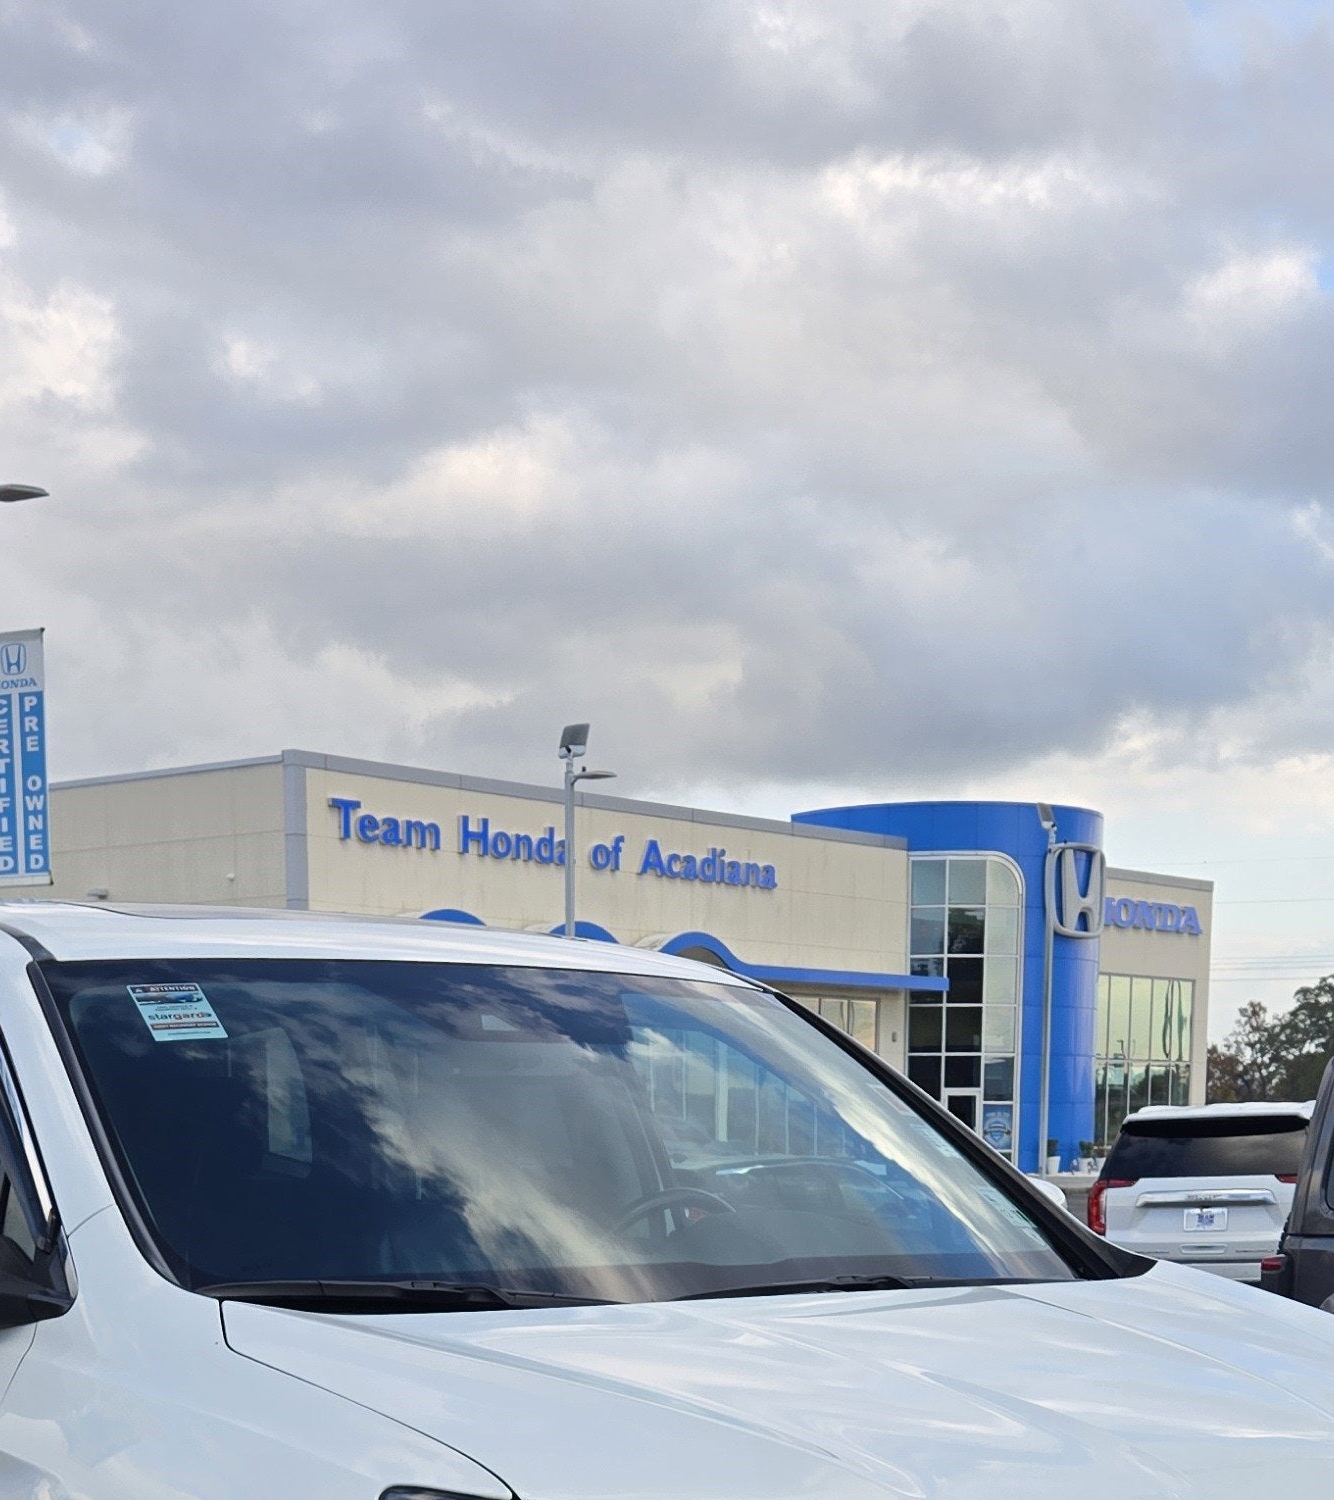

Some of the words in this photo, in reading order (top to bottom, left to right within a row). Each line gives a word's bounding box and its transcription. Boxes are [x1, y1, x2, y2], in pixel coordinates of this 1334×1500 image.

[23, 696, 40, 753] PRE
[25, 775, 46, 870] OWNED
[328, 796, 441, 851] Team
[589, 834, 626, 873] of
[636, 838, 778, 891] Acadiana
